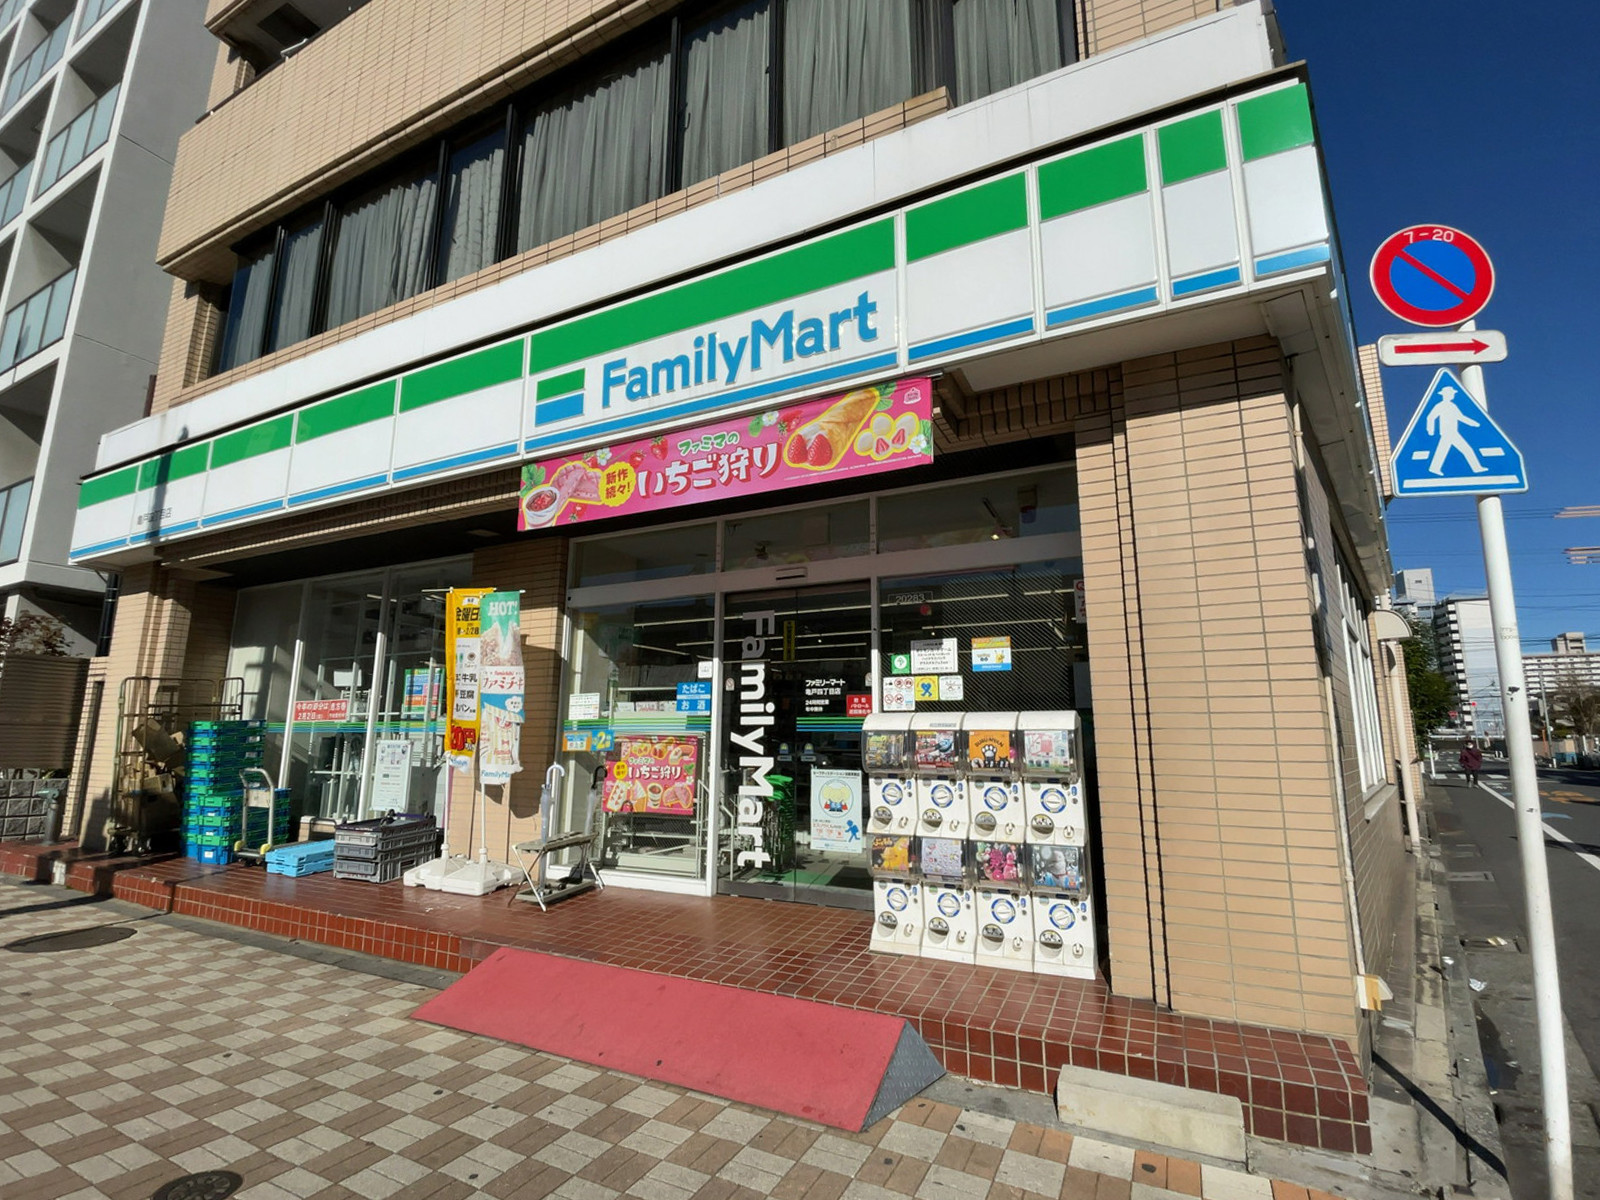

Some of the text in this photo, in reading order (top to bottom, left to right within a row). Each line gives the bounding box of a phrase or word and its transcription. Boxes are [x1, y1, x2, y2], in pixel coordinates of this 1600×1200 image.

[1404, 229, 1454, 243] 7-20
[602, 290, 878, 409] FamilyMart
[677, 430, 740, 457] ファミマの
[605, 468, 629, 485] 新作
[637, 442, 782, 498] いちご狩り
[488, 601, 518, 616] HOT!
[681, 683, 706, 694] たばこ
[805, 678, 846, 687] ファミリーマート
[730, 609, 776, 869] FamilyMart
[628, 765, 682, 780] いちご狩り
